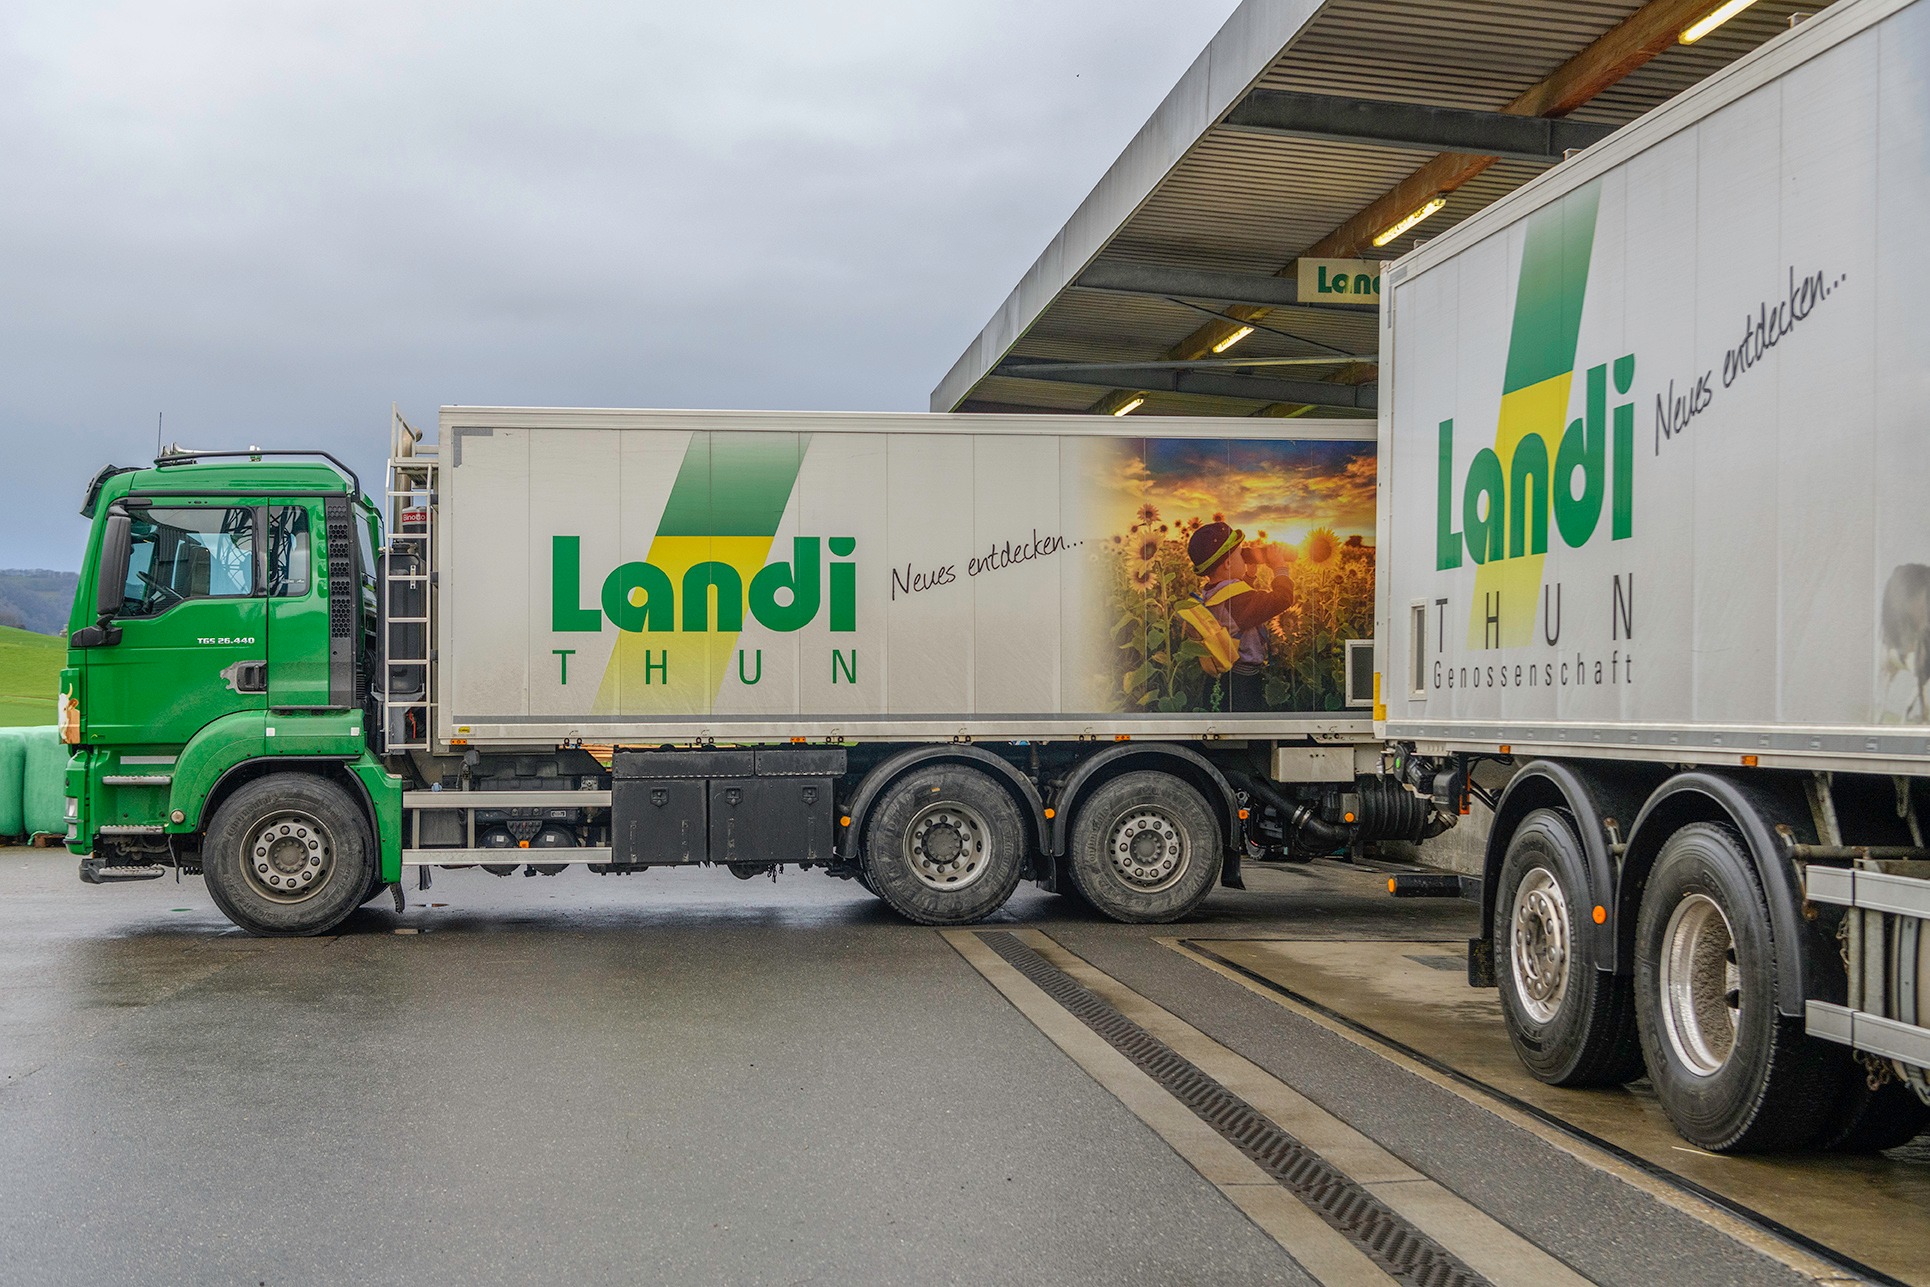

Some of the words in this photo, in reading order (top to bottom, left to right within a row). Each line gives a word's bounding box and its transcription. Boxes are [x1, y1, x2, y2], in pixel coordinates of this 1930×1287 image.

[1318, 266, 1379, 294] Lan
[1656, 370, 1712, 456] Neues
[1723, 265, 1846, 389] entdecken...
[1436, 355, 1635, 571] Landi
[552, 537, 856, 632] Landi
[892, 563, 956, 601] Neues
[968, 529, 1084, 576] entdecken...
[196, 637, 216, 645] TGS
[217, 637, 256, 645] 26.440
[1435, 572, 1633, 653] THUN
[553, 649, 857, 685] THUN
[1433, 651, 1633, 689] Genossenschaft
